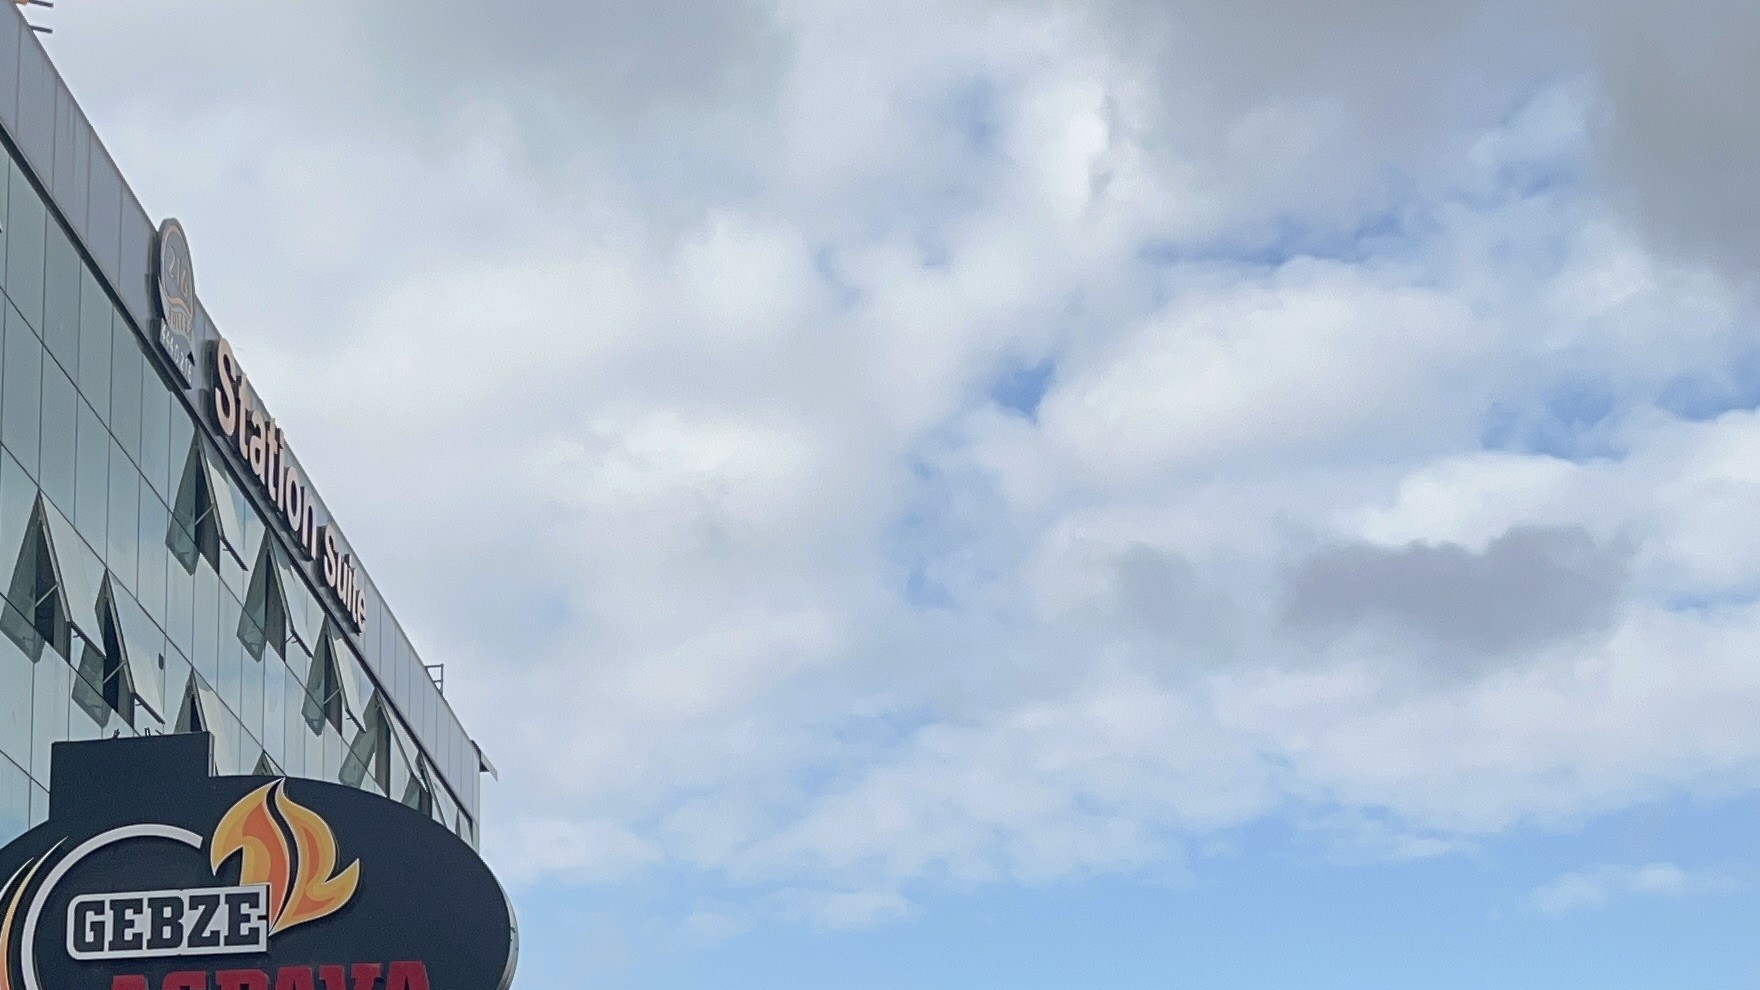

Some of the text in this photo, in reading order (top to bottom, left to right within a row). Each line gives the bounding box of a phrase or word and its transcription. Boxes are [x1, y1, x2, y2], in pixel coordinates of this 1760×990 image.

[214, 337, 366, 635] Station Suite
[75, 889, 265, 952] GEBZE
